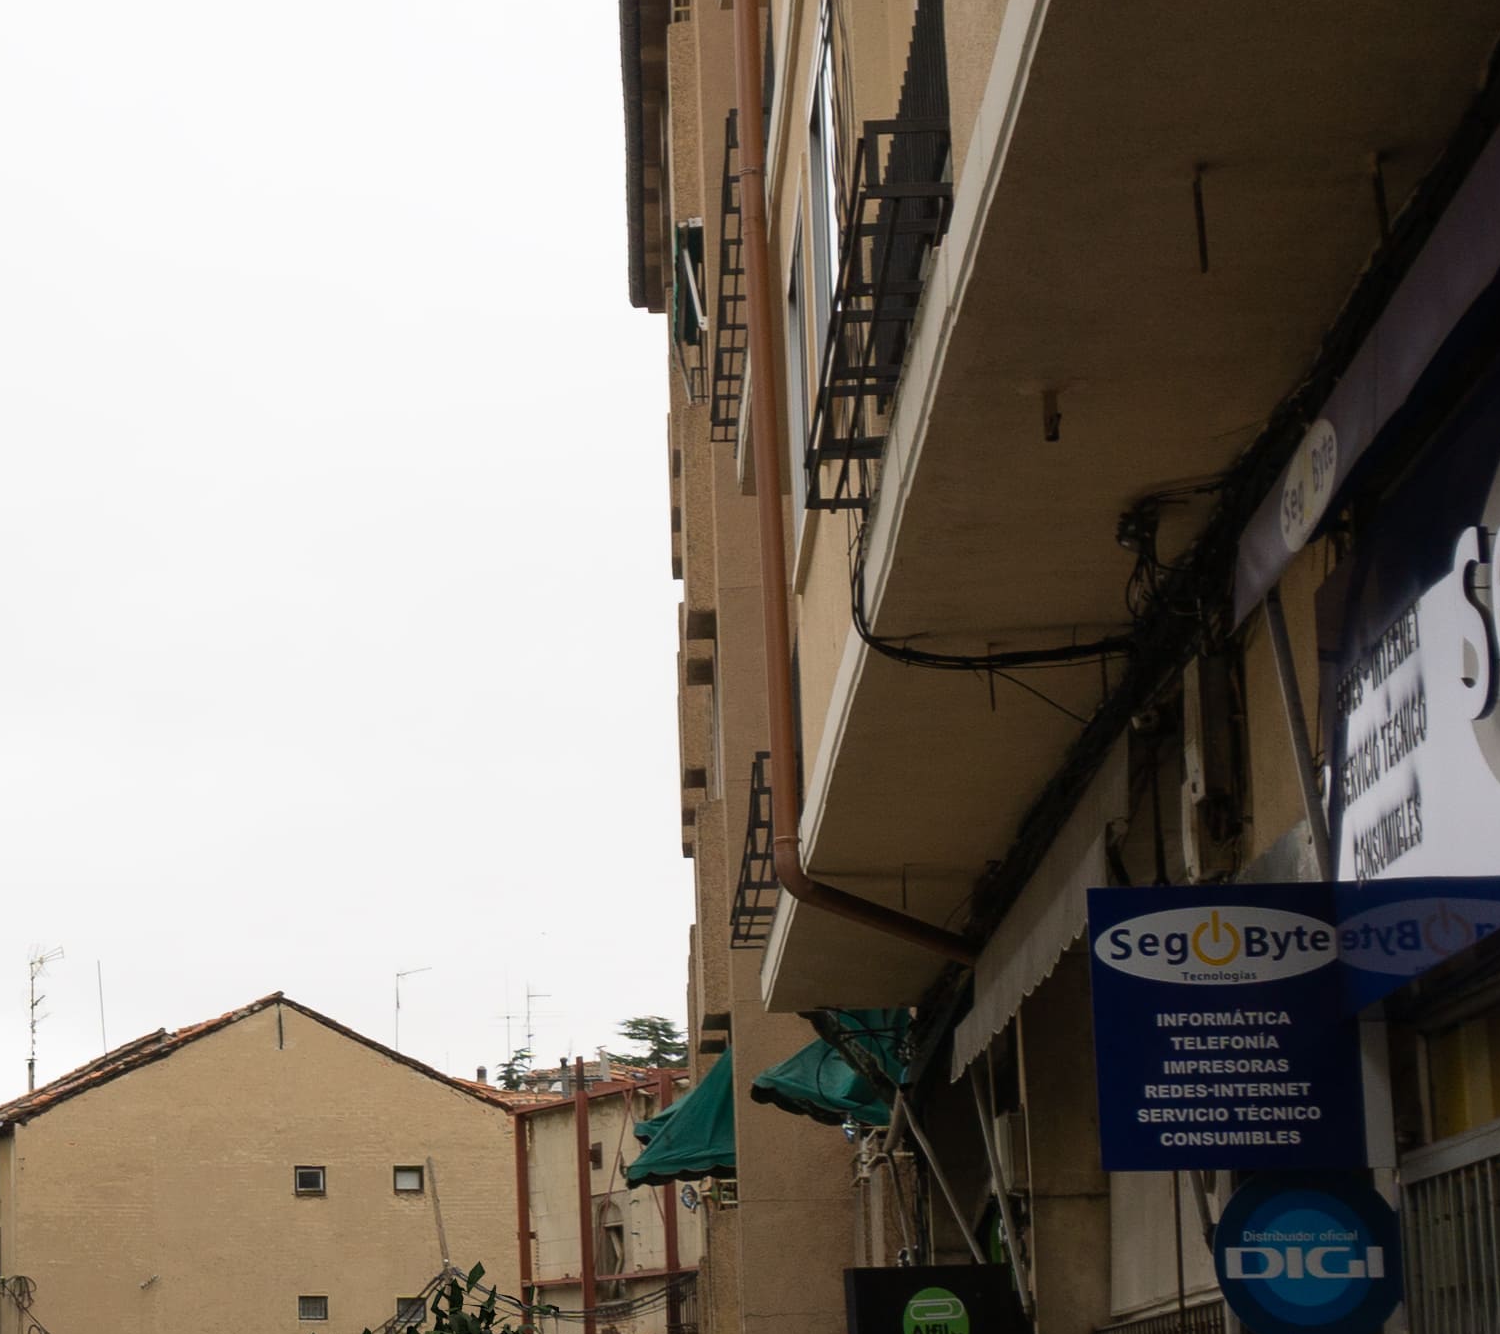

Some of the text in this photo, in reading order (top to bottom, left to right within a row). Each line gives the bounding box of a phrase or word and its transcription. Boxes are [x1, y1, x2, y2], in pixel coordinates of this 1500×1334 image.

[1180, 969, 1257, 984] Tecnologías
[1156, 1009, 1291, 1027] INFORMÁTICA
[1170, 1033, 1280, 1052] TELEFONÍA
[1163, 1058, 1290, 1075] IMPRESORAS
[1144, 1081, 1312, 1100] REDES-INTERNET
[1137, 1104, 1322, 1124] SERVICIO TÉCNICO
[1160, 1129, 1302, 1147] CONSUMIBLES
[1242, 1228, 1359, 1243] Distribuidor oficial
[1225, 1245, 1385, 1280] DIGI
